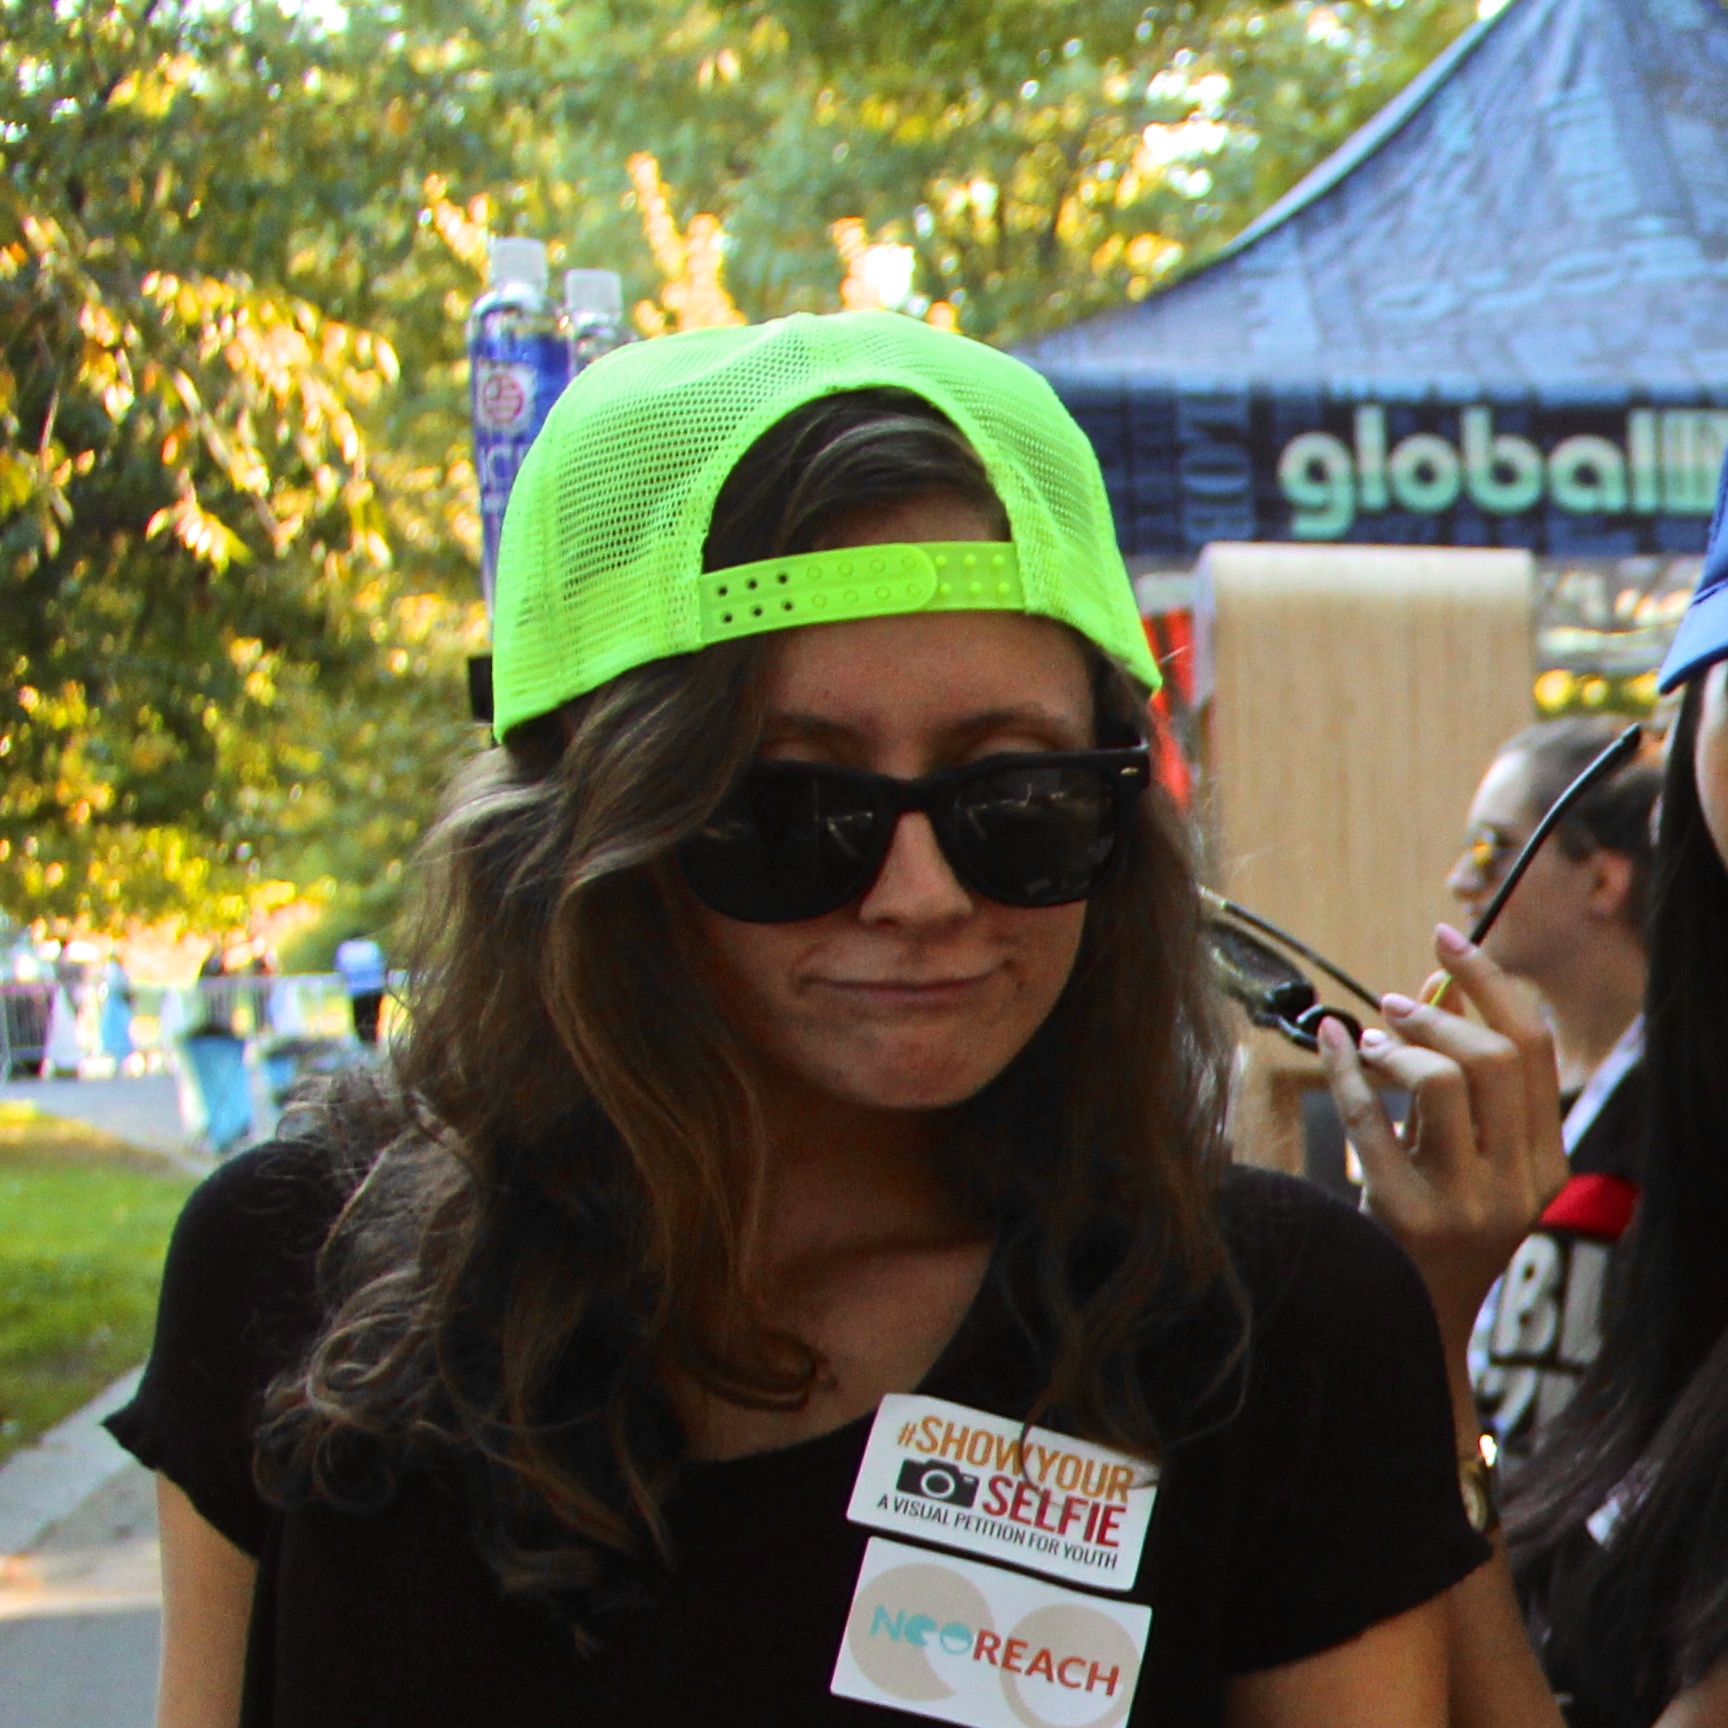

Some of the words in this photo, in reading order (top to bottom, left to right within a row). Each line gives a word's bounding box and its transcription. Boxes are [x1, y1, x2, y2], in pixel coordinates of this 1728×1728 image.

[1276, 403, 1657, 541] global
[896, 1414, 1136, 1503] #SHOWYOUR
[876, 1494, 889, 1511] A
[892, 1496, 951, 1526] VISUAL
[953, 1511, 1026, 1548] PETITION
[1027, 1534, 1062, 1557] FOR
[1062, 1541, 1120, 1571] YOUTH
[981, 1473, 1128, 1549] SELFIE
